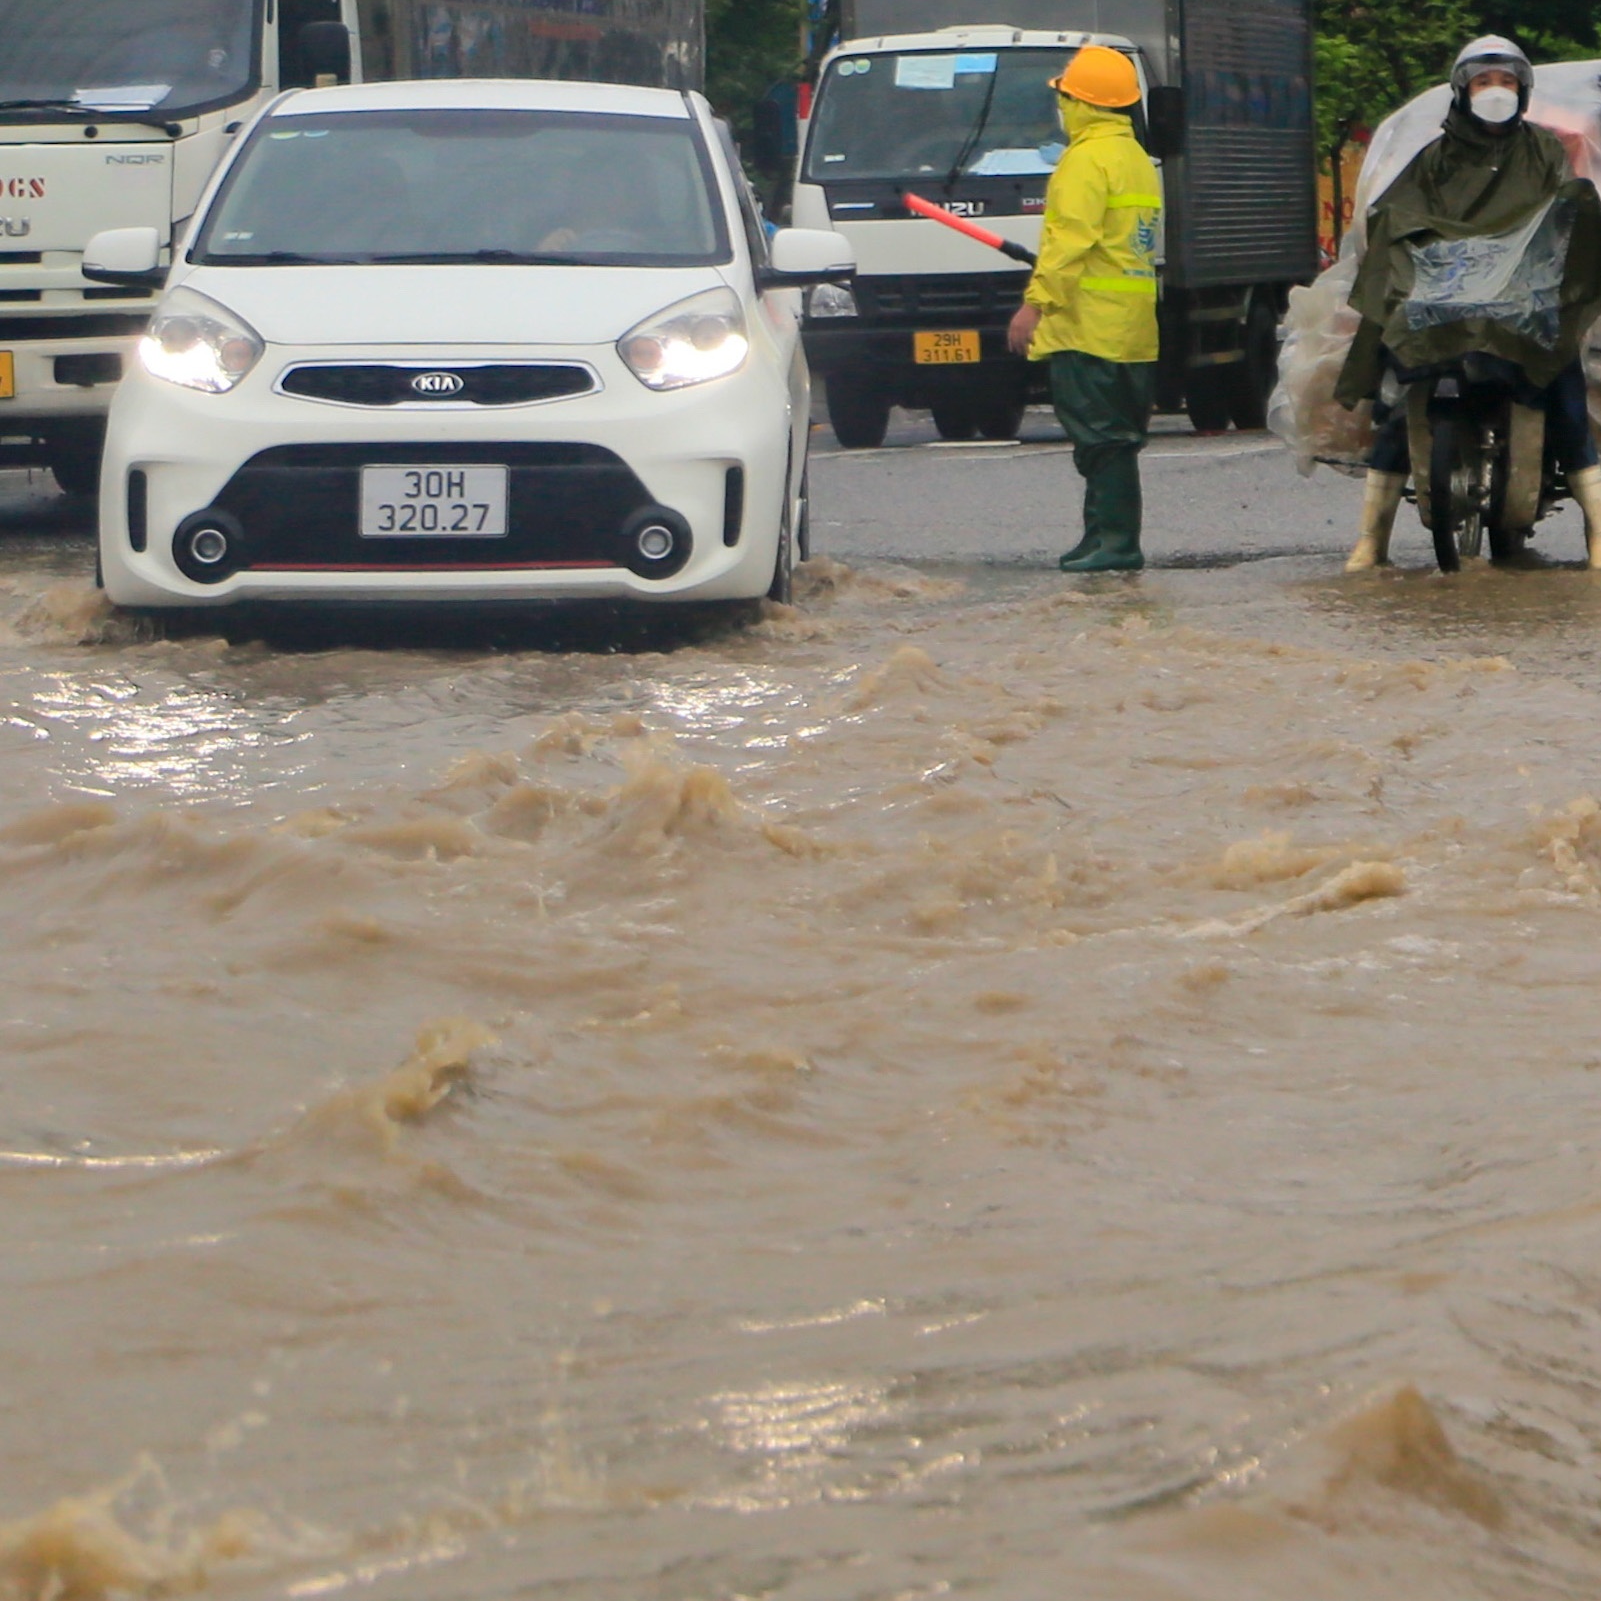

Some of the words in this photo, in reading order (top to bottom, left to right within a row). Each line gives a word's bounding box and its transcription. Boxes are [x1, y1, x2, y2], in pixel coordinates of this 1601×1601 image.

[105, 154, 165, 165] NQR
[0, 177, 46, 198] GS
[934, 333, 961, 347] 29H
[420, 376, 456, 391] KIA
[404, 470, 465, 499] 30H
[378, 503, 490, 531] 320.27
